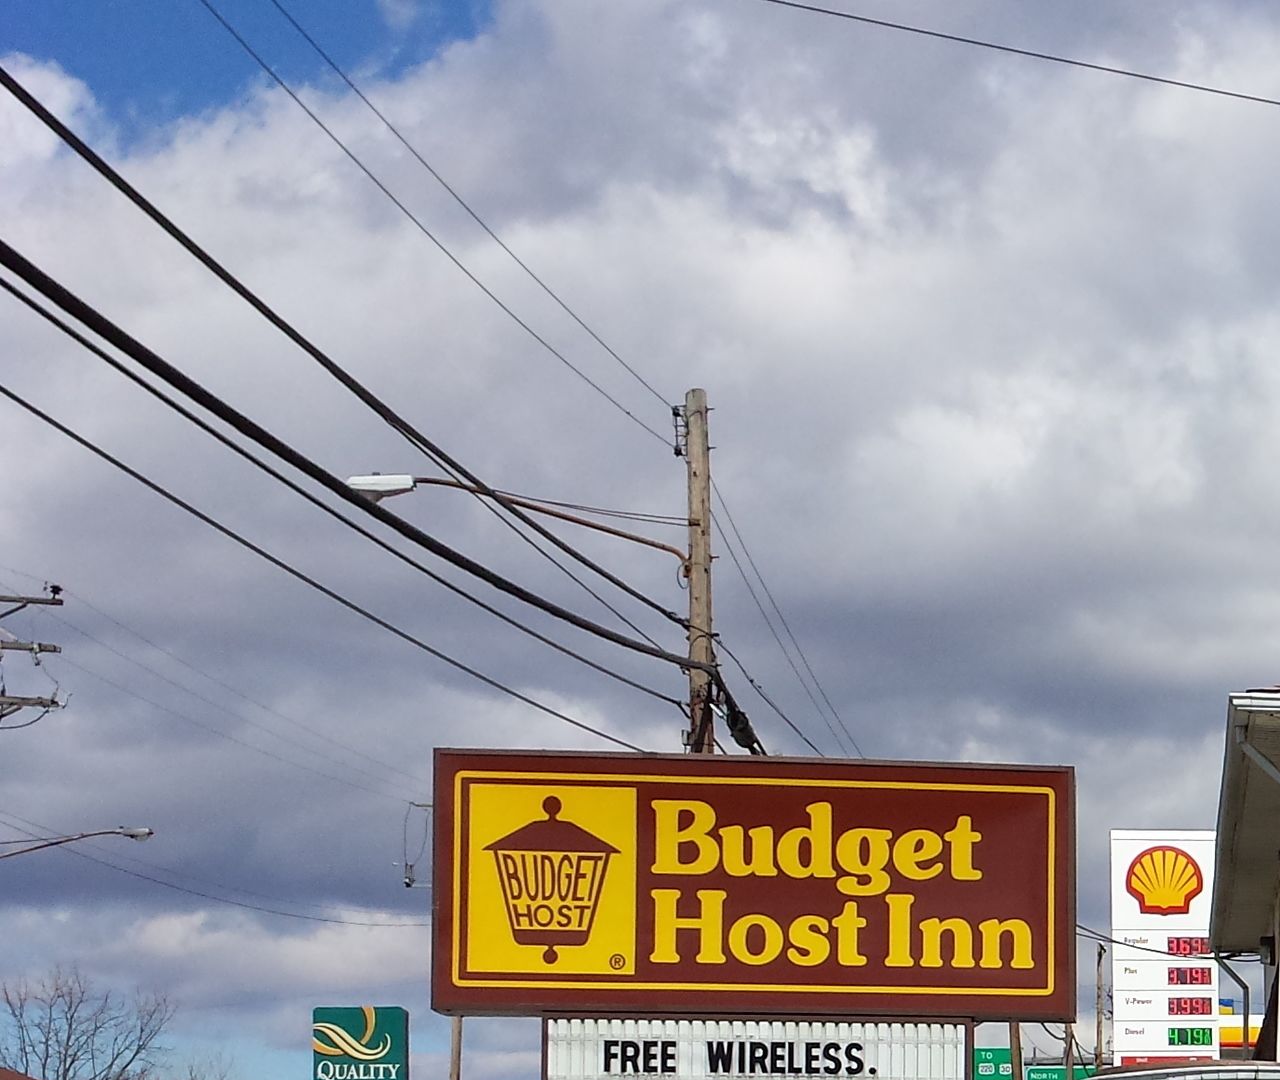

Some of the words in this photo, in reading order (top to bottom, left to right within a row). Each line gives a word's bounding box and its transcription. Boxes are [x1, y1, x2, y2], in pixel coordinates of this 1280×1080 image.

[650, 800, 982, 895] Budget
[502, 854, 604, 902] BUDGET
[512, 904, 592, 928] HOST
[650, 889, 867, 966] Host
[885, 894, 1034, 969] Inn
[604, 1040, 677, 1075] FREE
[706, 1041, 877, 1076] WIRELESS.
